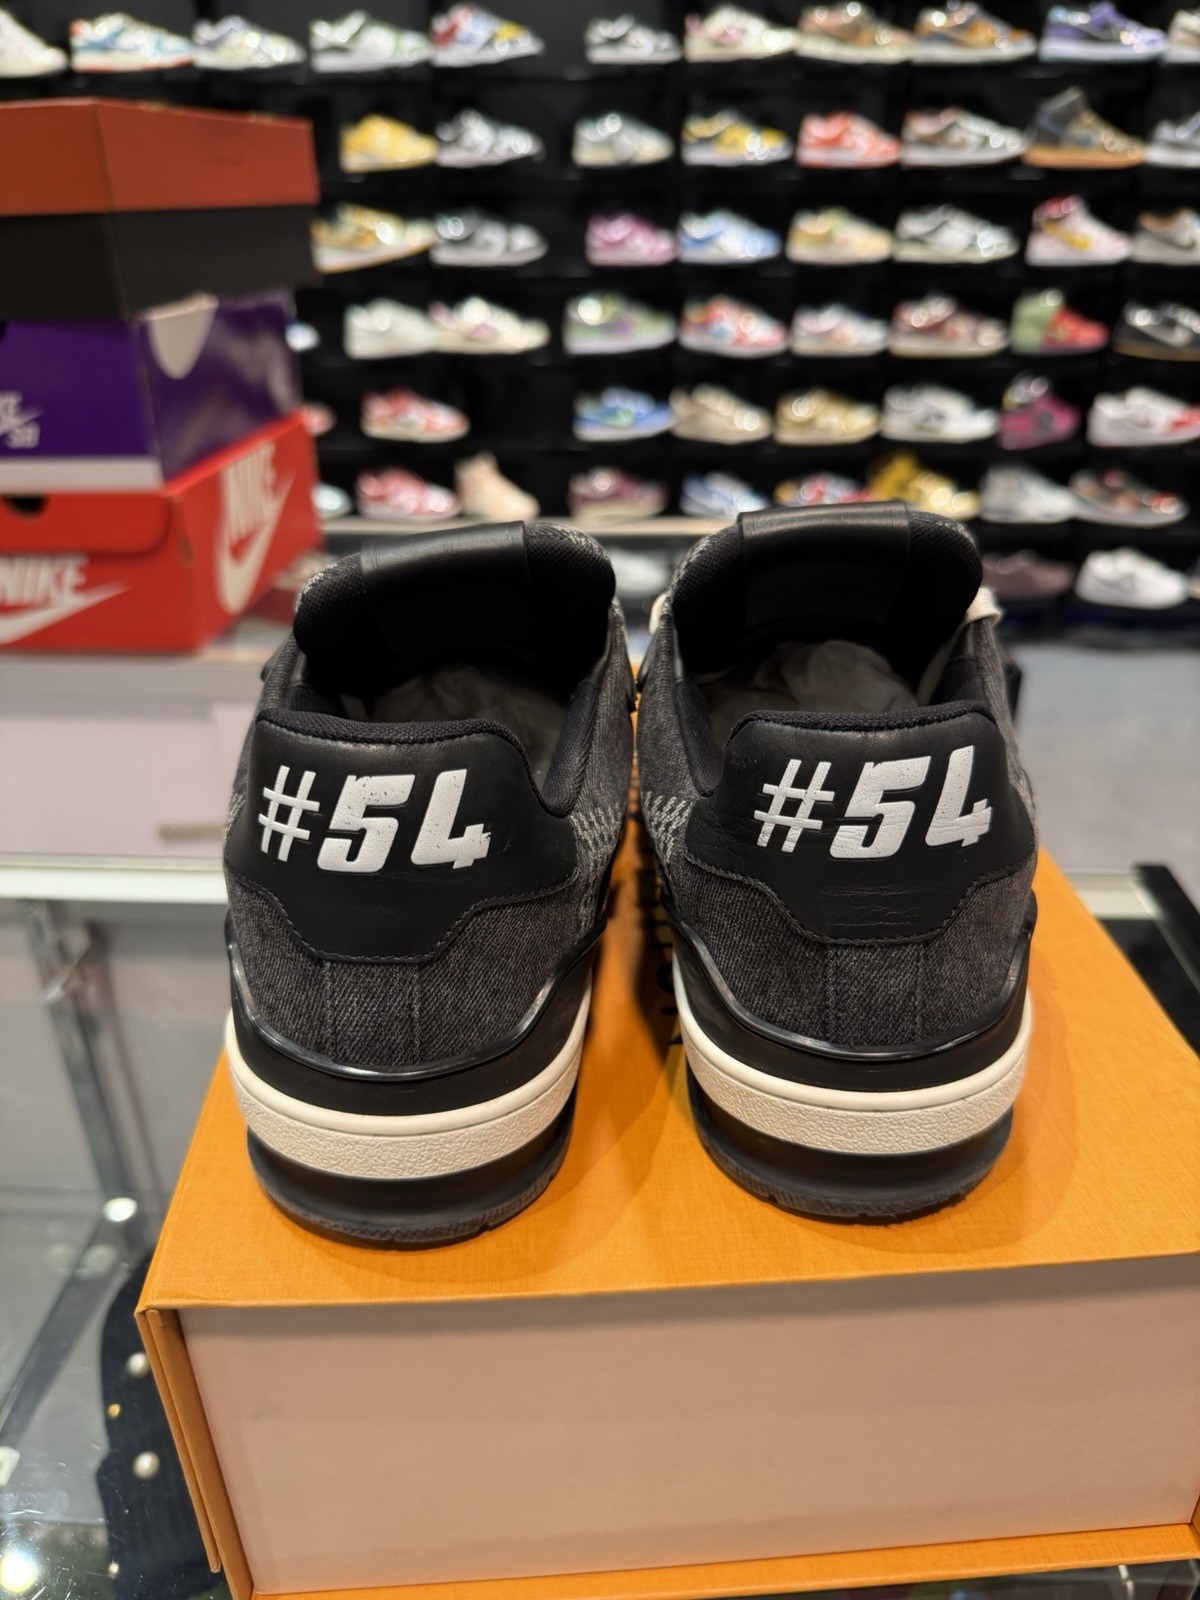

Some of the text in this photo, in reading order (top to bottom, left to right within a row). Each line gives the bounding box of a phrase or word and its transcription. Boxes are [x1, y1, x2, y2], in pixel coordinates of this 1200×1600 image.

[222, 443, 276, 543] NIKE
[258, 765, 491, 872] #54
[754, 745, 992, 858] #54
